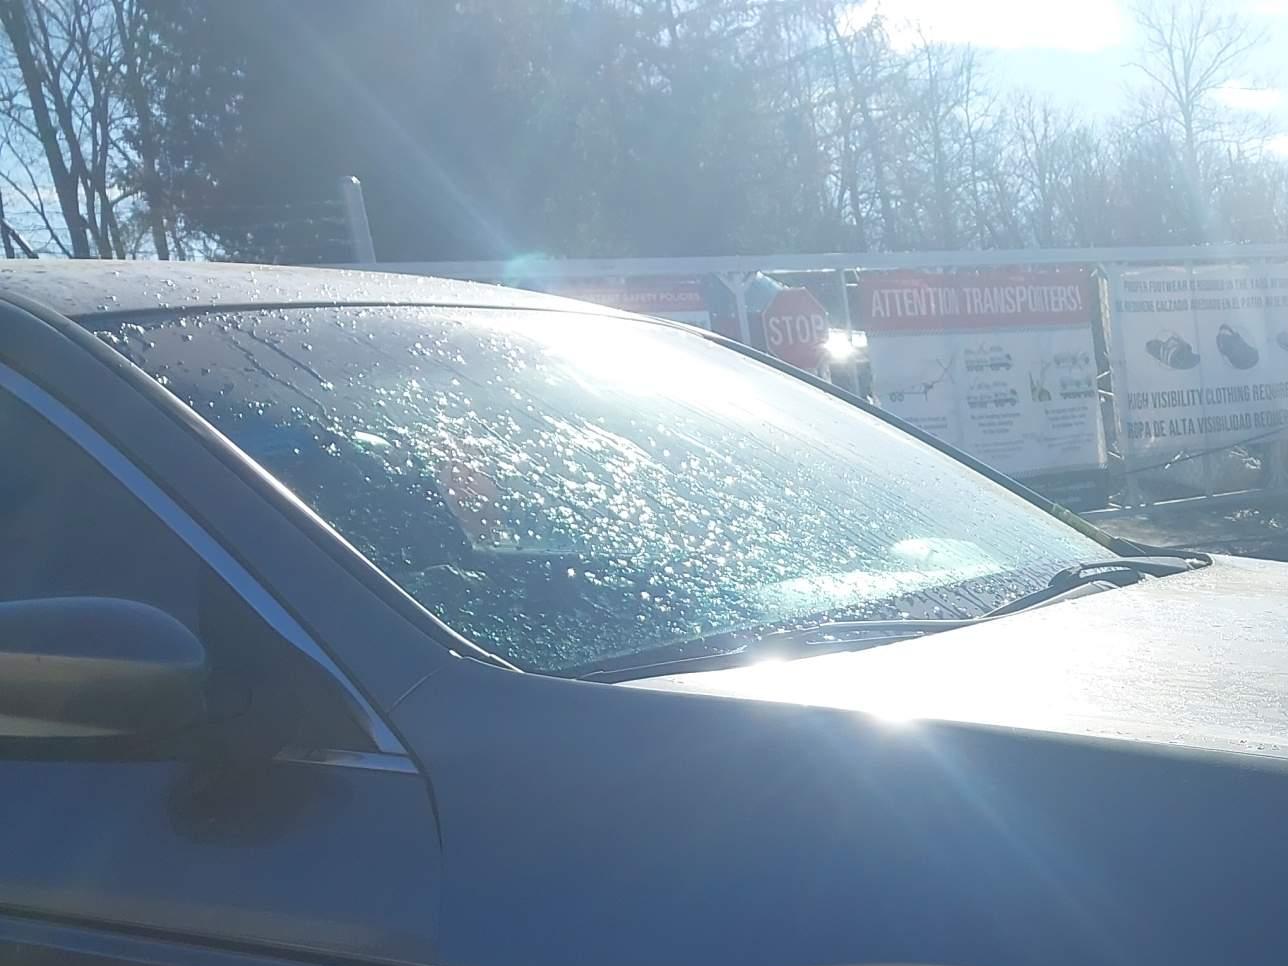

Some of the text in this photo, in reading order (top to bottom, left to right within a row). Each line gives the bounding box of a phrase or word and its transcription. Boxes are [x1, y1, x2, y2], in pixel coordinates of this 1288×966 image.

[872, 287, 959, 318] ATTENTION
[768, 314, 825, 345] STOP
[1128, 391, 1149, 409] HIGH
[1151, 388, 1203, 409] VISIBILITY
[1205, 385, 1250, 405] CLOTHING
[1127, 421, 1152, 439] ROPA
[1153, 420, 1167, 437] DE
[1169, 418, 1196, 437] ALTA
[1197, 413, 1252, 435] VISIBILIDAD
